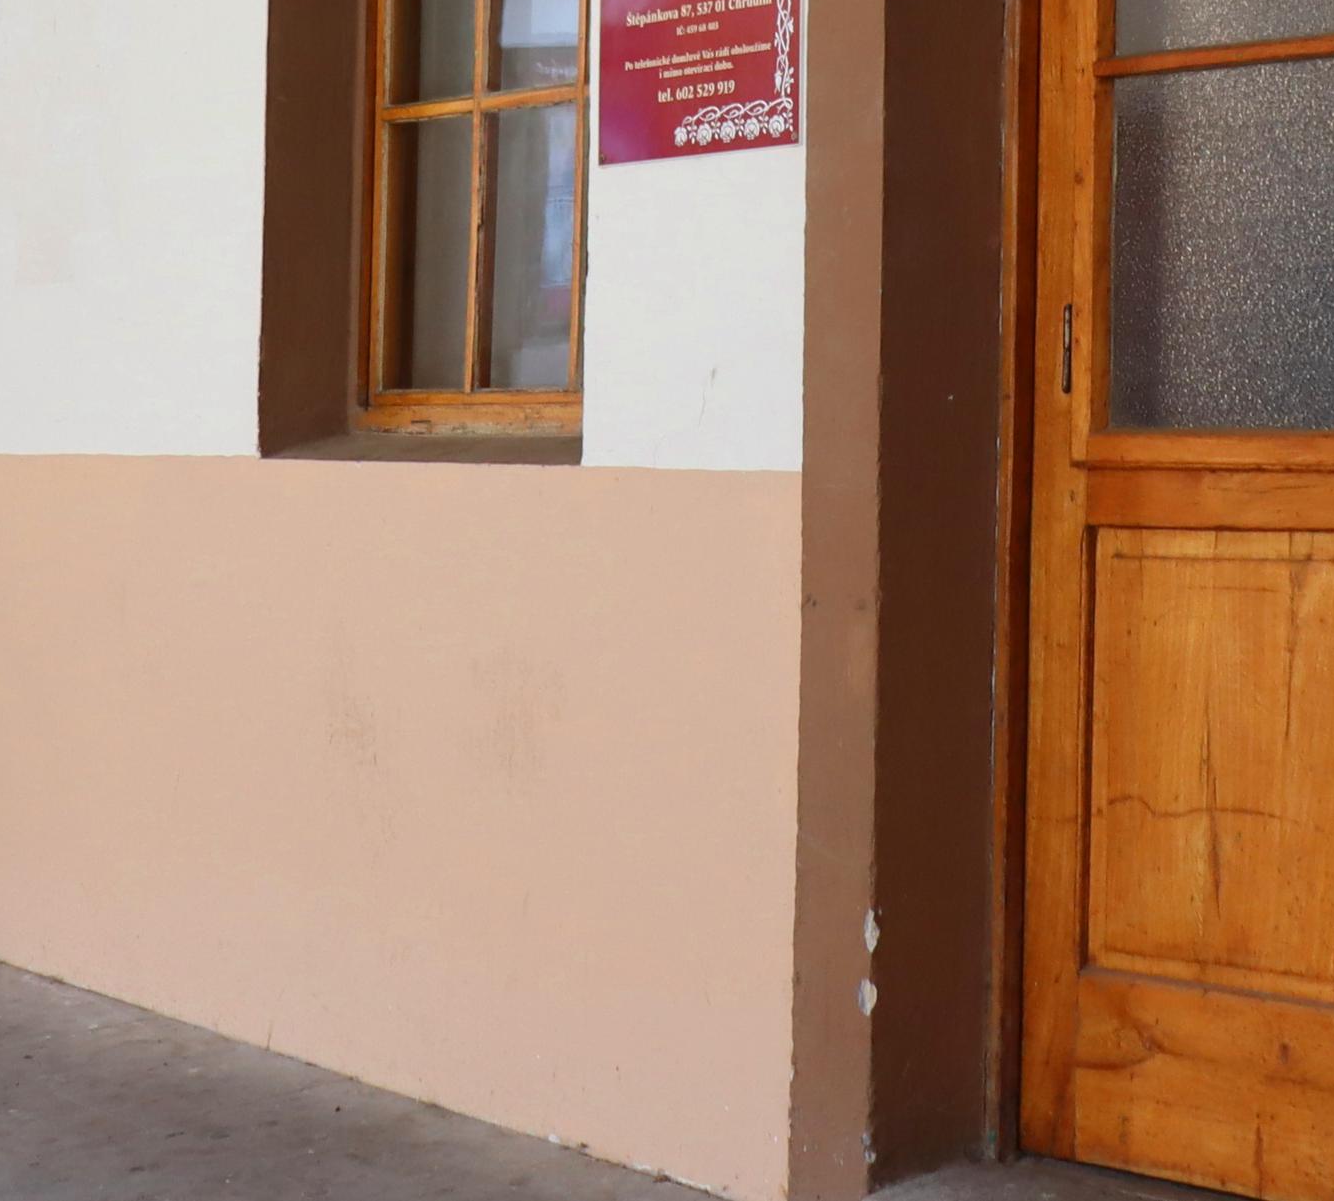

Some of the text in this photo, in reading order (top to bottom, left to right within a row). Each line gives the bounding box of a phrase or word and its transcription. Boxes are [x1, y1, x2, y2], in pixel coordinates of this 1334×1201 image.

[625, 9, 679, 29] Štěpánkova
[680, 4, 695, 18] 87,
[696, 3, 713, 16] 537
[715, 0, 726, 12] 01
[658, 79, 735, 103] tel. 602 529 919
